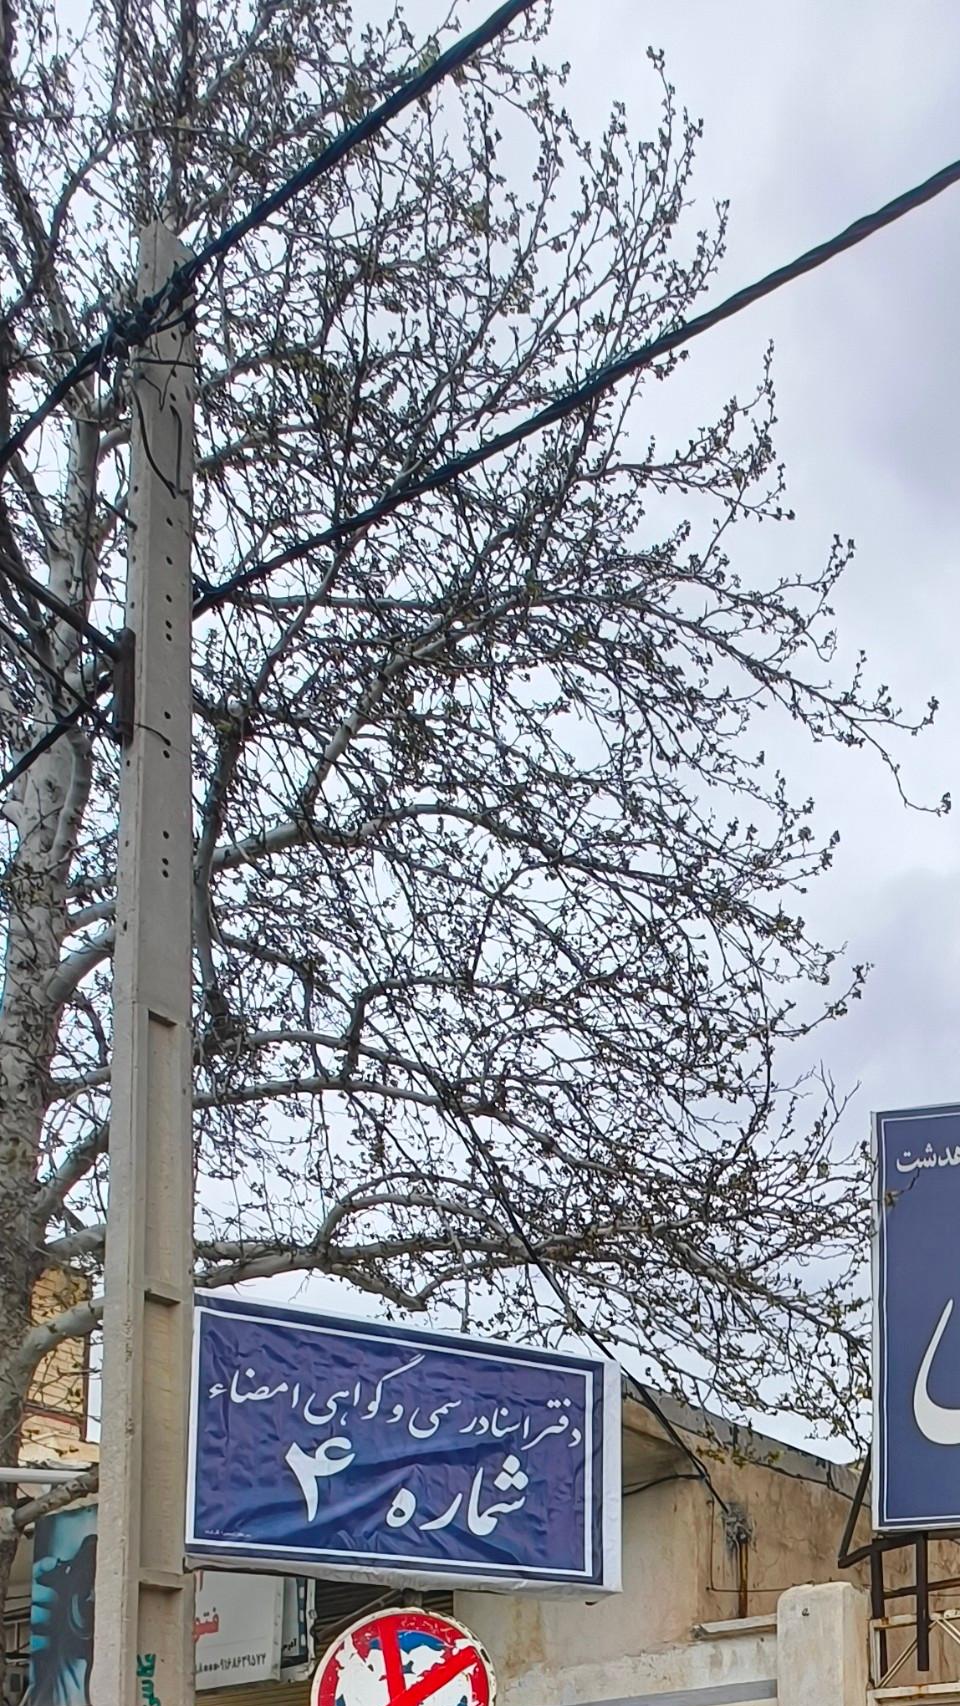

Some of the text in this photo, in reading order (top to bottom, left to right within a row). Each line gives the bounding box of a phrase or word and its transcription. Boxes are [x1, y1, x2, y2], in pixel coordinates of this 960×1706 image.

[209, 1354, 582, 1450] دفتر اسناد رسمی و گواهی امضاء
[285, 1436, 530, 1537] شماره ۴
